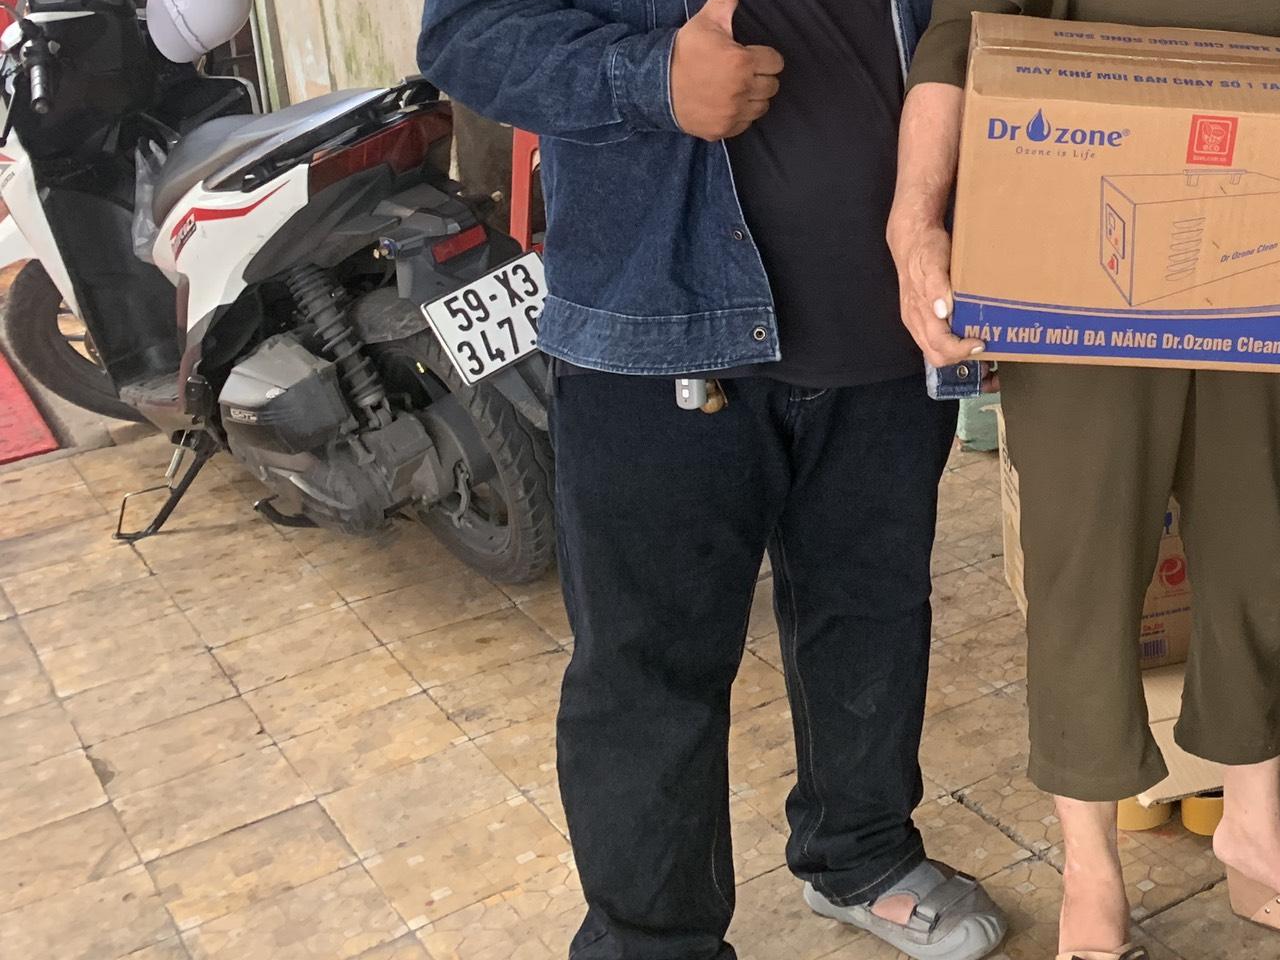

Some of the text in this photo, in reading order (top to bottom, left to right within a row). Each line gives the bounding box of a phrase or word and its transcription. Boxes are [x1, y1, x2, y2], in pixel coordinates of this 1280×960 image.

[1015, 145, 1096, 161] Ozone is Life
[443, 264, 539, 332] 59-X3
[1006, 322, 1044, 344] KHỬ
[1046, 325, 1079, 345] MÙI
[1083, 330, 1106, 347] ĐA
[1111, 328, 1157, 348] NĂNG
[1162, 333, 1232, 352] Dr.Ozone
